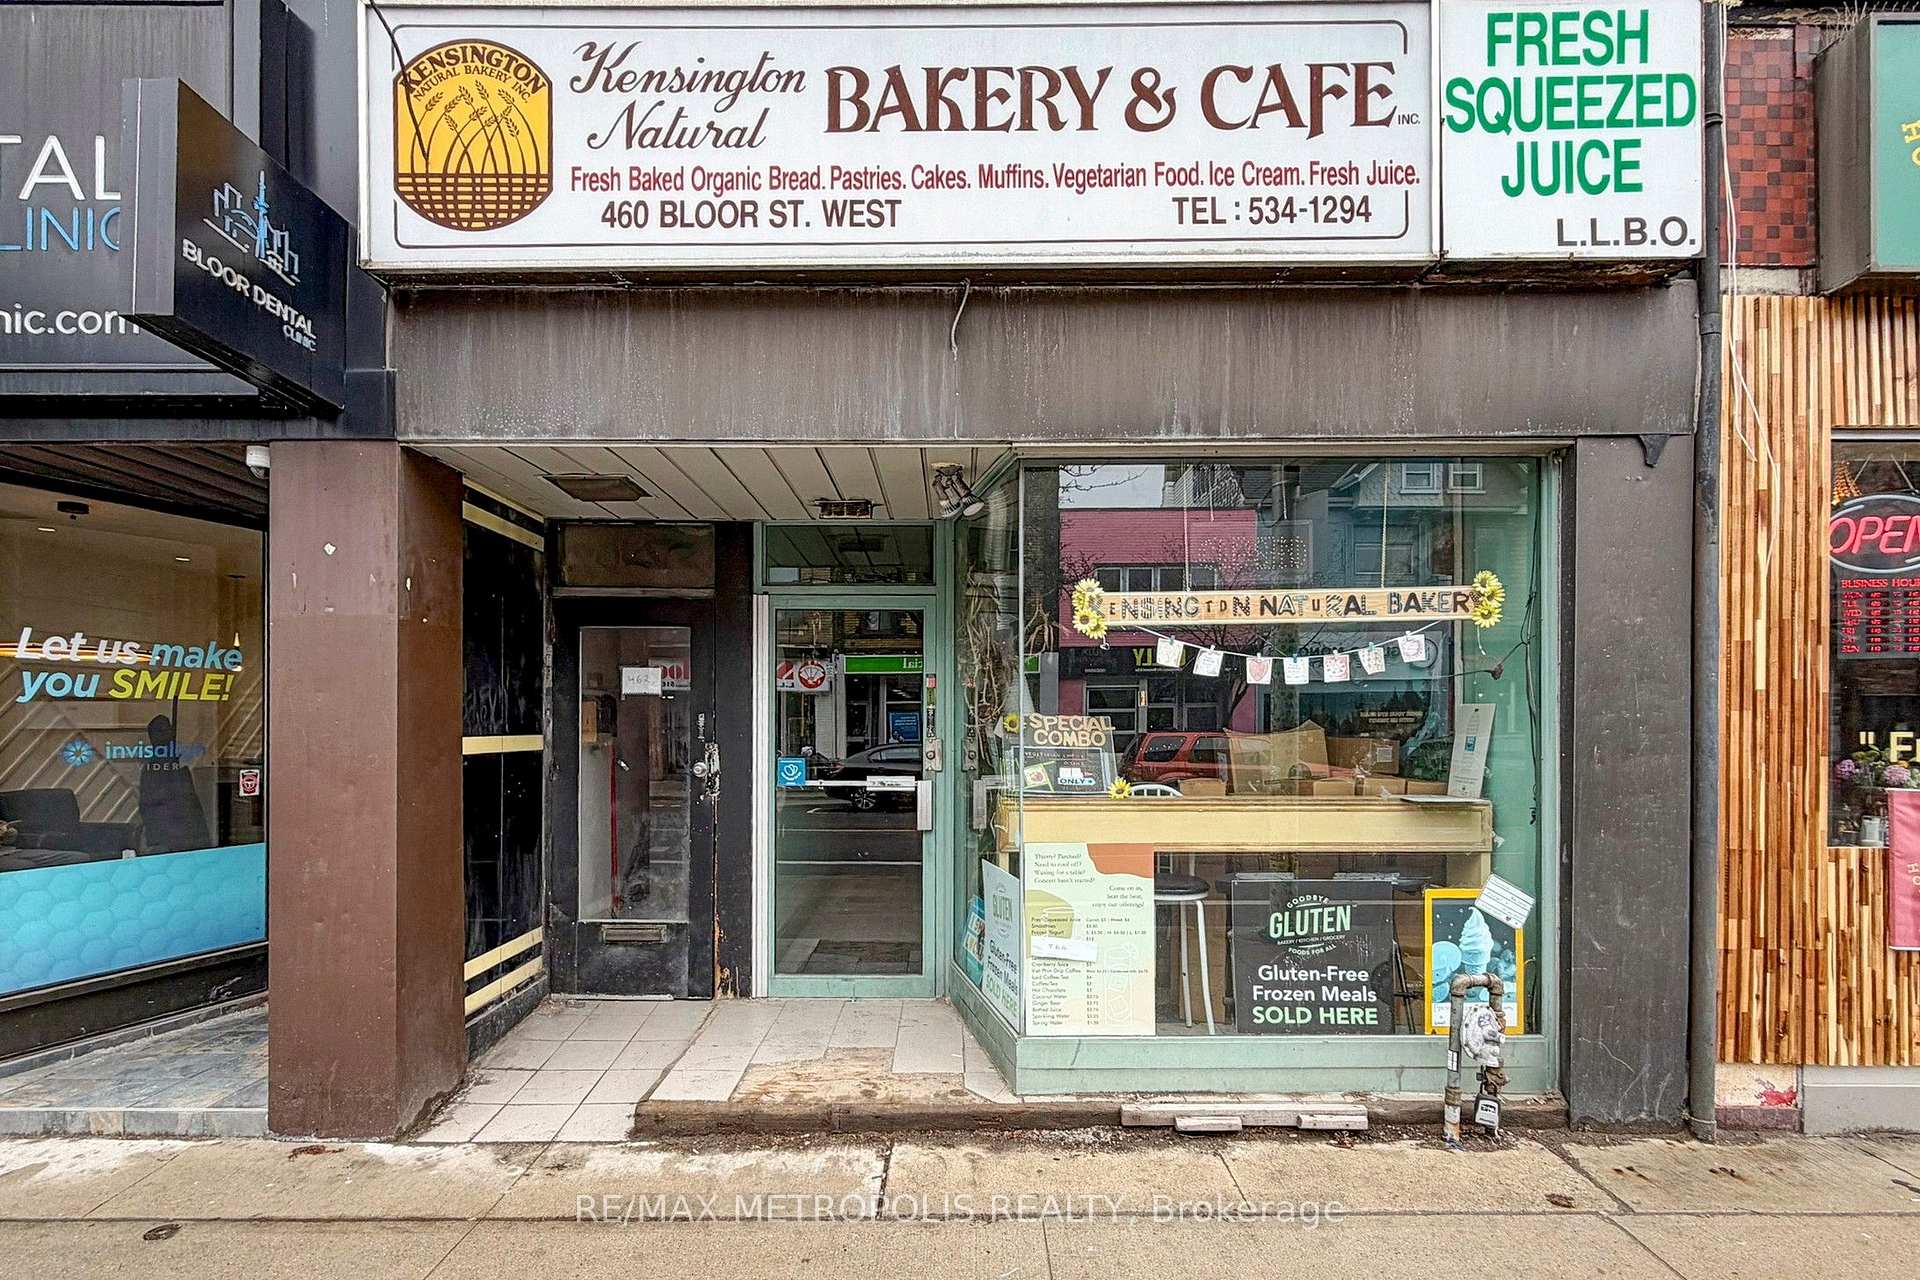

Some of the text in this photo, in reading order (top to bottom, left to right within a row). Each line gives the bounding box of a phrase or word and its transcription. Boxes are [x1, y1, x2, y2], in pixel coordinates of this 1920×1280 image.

[1487, 9, 1649, 67] FRESH
[400, 45, 546, 94] KENSINGTON
[413, 65, 531, 103] NATURAL BAKERY INC.
[569, 40, 806, 113] Kensington
[824, 61, 1421, 141] BAKERY & CAFE INC.
[1445, 73, 1697, 137] SQUEEZED
[587, 99, 770, 149] Natural
[571, 160, 1420, 197] Fresh Baked Organic Bread. Pastries. Cakes. Muffins. Vegetarian Food. Ice Cream. Fresh Juice.
[1501, 138, 1643, 198] JUICE
[601, 199, 902, 228] 460 BLOOR ST. WEST
[1249, 195, 1372, 224] 534-1294
[1556, 216, 1696, 247] L.L.B.O.
[183, 239, 317, 339] BLOOR DENTAL
[283, 324, 316, 352] CLINIC
[1841, 579, 1889, 589] BUSINESS
[1260, 594, 1377, 617] NATURAL
[16, 627, 242, 671] Let us make
[16, 668, 235, 703] you SMILE!
[1029, 713, 1116, 731] SPECIAL
[1033, 729, 1106, 747] COMBO
[1286, 894, 1330, 909] GOODBYE
[1269, 905, 1351, 938] GLUTEN
[1288, 947, 1310, 955] FOODS
[1325, 943, 1337, 952] ALL
[1258, 965, 1369, 982] Gluten-Free
[1252, 985, 1378, 1002] Frozen Meals
[1252, 1007, 1378, 1025] SOLD HERE
